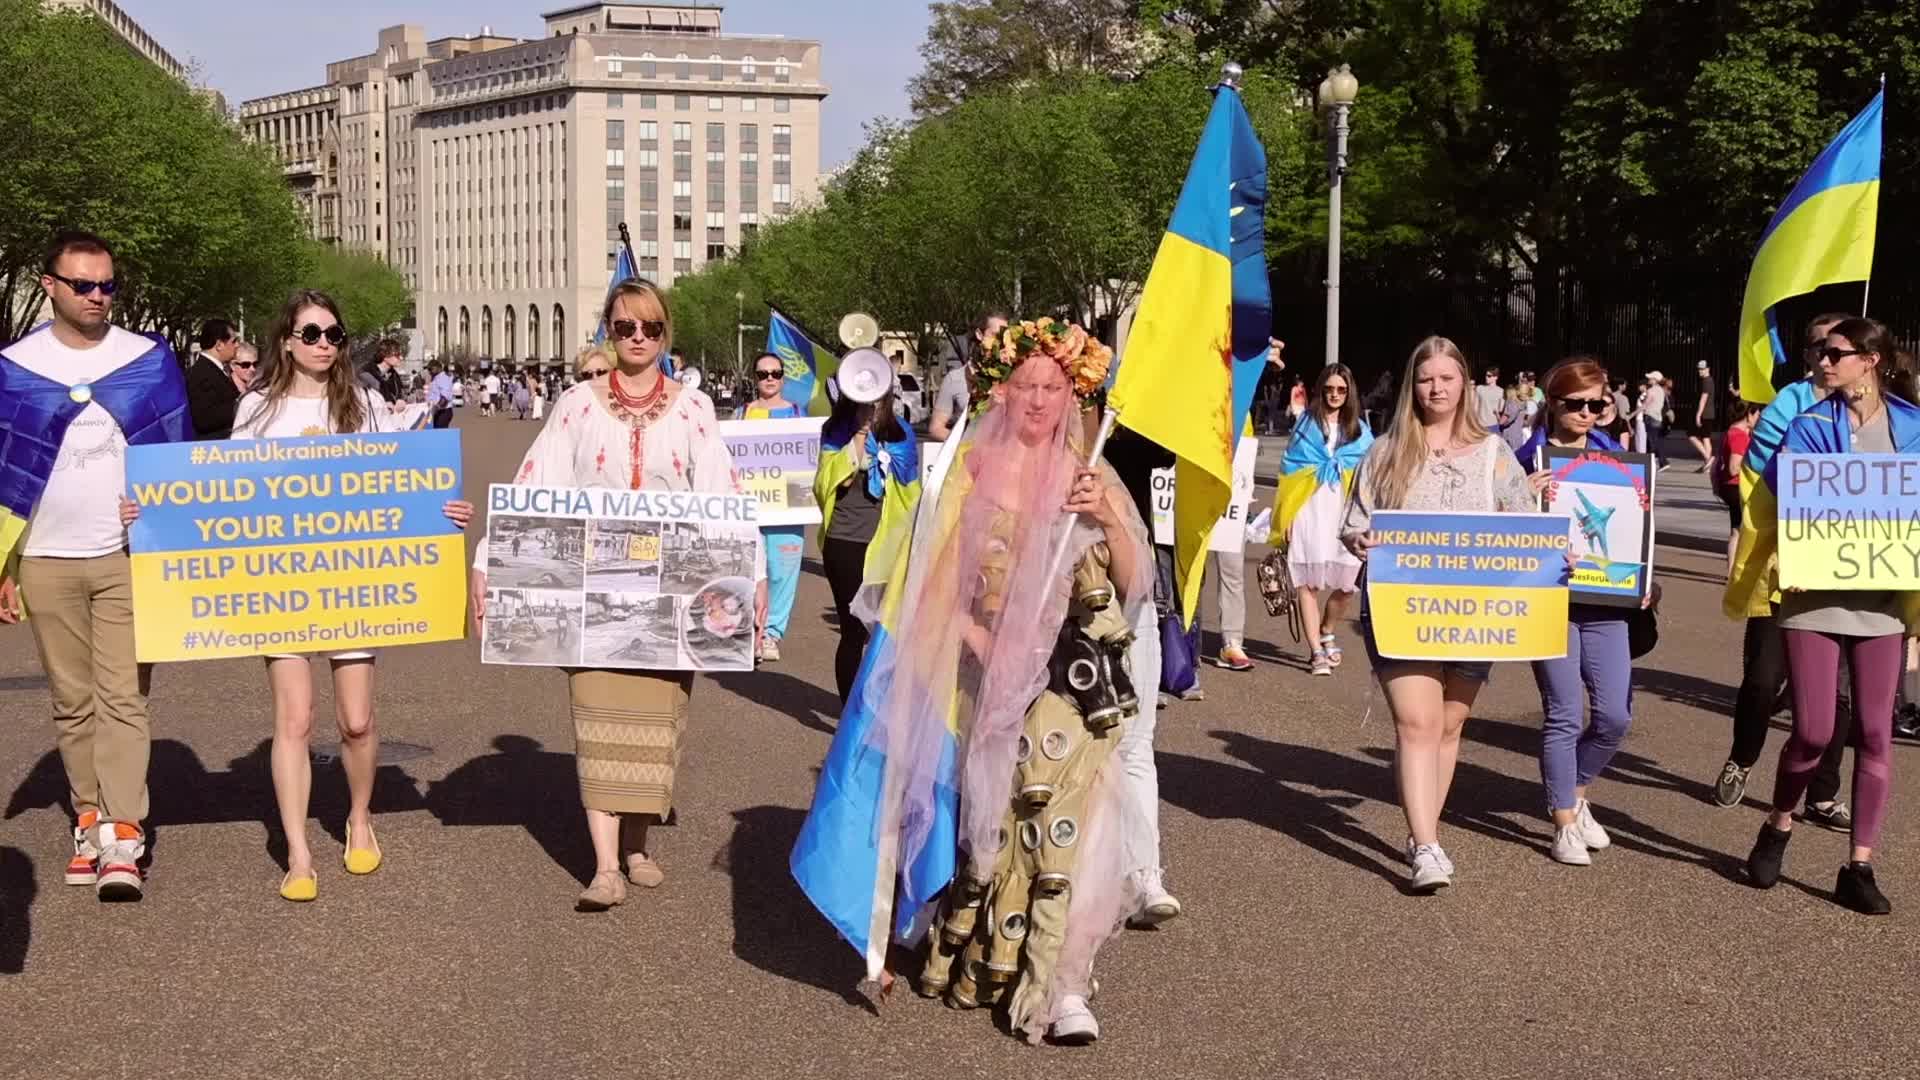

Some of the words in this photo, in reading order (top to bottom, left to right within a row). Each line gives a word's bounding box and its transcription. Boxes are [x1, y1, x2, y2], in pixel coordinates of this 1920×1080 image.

[190, 438, 399, 465] #ArmUkraineNow
[726, 443, 749, 457] ND
[754, 441, 804, 457] MORE
[132, 480, 256, 507] WOULD
[264, 472, 333, 500] YOU
[341, 466, 457, 495] DEFEND
[760, 465, 782, 480] TO
[1152, 475, 1176, 491] OR
[1791, 459, 1919, 498] PROTE
[490, 486, 593, 514] BUCHA
[601, 491, 759, 522] MASSACRE
[195, 514, 285, 542] YOUR
[292, 506, 404, 538] HOME?
[1369, 530, 1450, 547] UKRAINE
[1454, 532, 1471, 548] IS
[1474, 533, 1569, 550] STANDING
[162, 555, 235, 581] HELP
[244, 543, 440, 577] UKRAINIANS
[1396, 553, 1433, 569] FOR
[1436, 554, 1468, 571] THE
[1472, 555, 1540, 573] WORLD
[1833, 542, 1920, 580] SKY
[190, 589, 311, 619] DEFEND
[317, 581, 418, 611] THEIRS
[1405, 597, 1478, 616] STAND
[1484, 599, 1528, 617] FOR
[183, 617, 429, 650] #WeaponsForUkraine
[1416, 626, 1518, 645] UKRAINE
